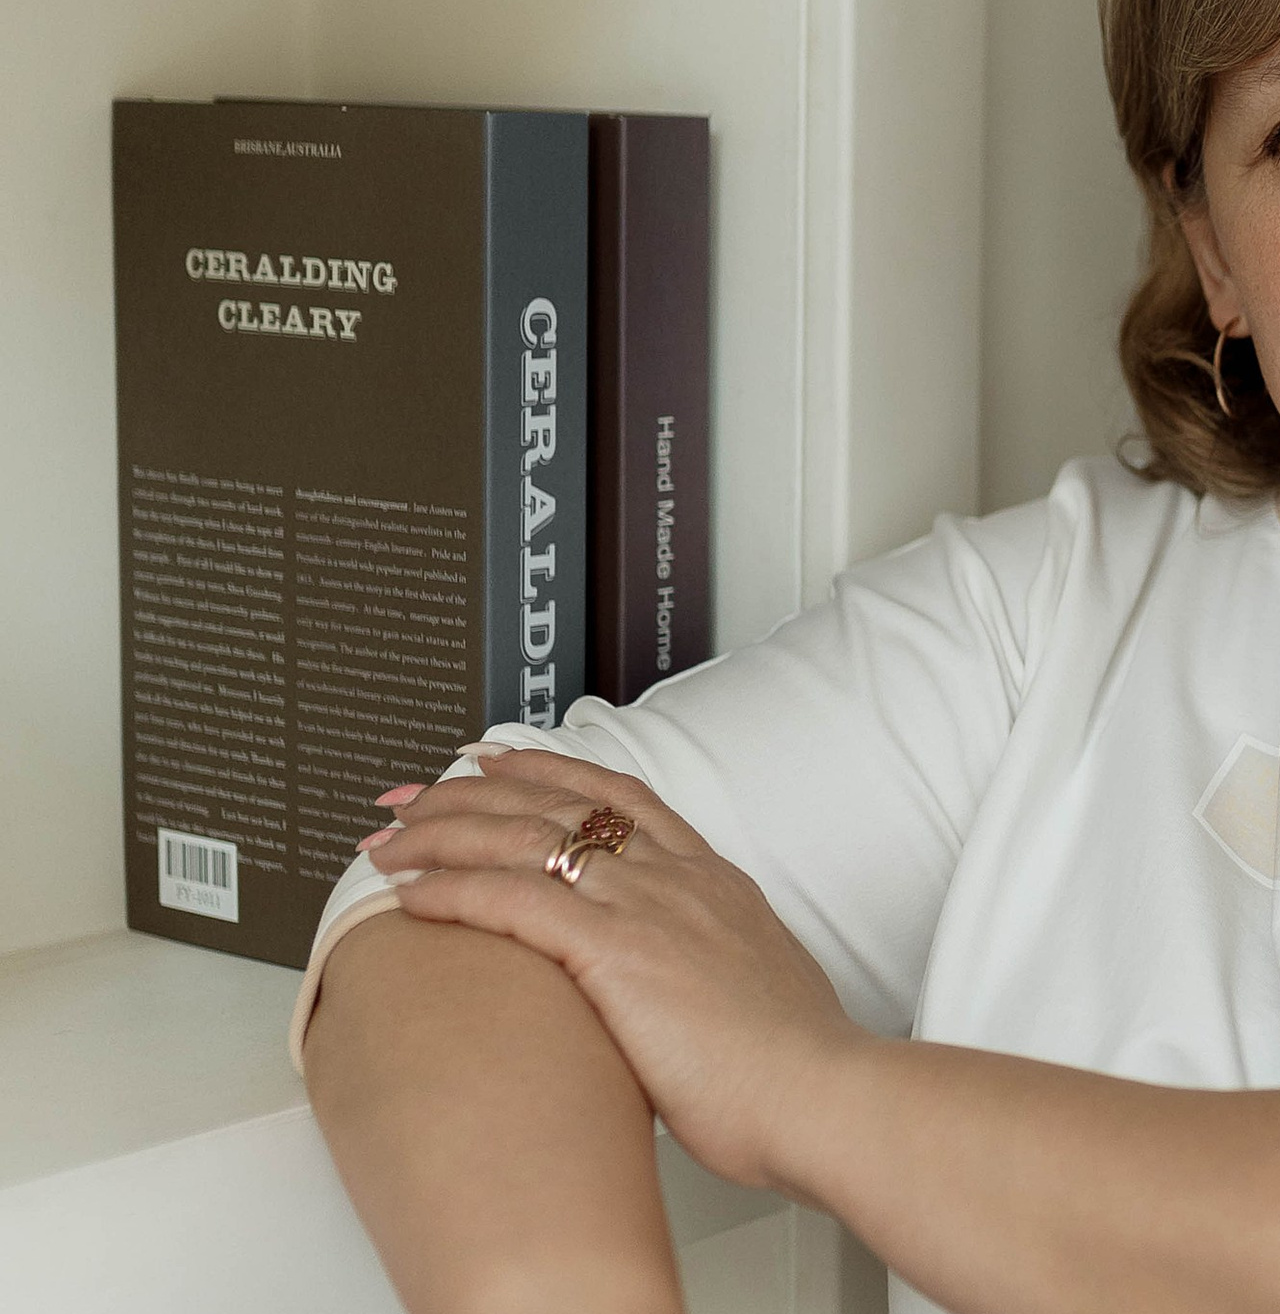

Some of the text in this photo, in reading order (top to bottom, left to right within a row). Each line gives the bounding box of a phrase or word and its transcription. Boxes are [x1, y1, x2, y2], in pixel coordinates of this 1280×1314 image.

[185, 247, 399, 295] CERALDING
[217, 299, 363, 344] CLEARY
[520, 297, 558, 729] CERALDI
[656, 415, 675, 671] Hand Made Home
